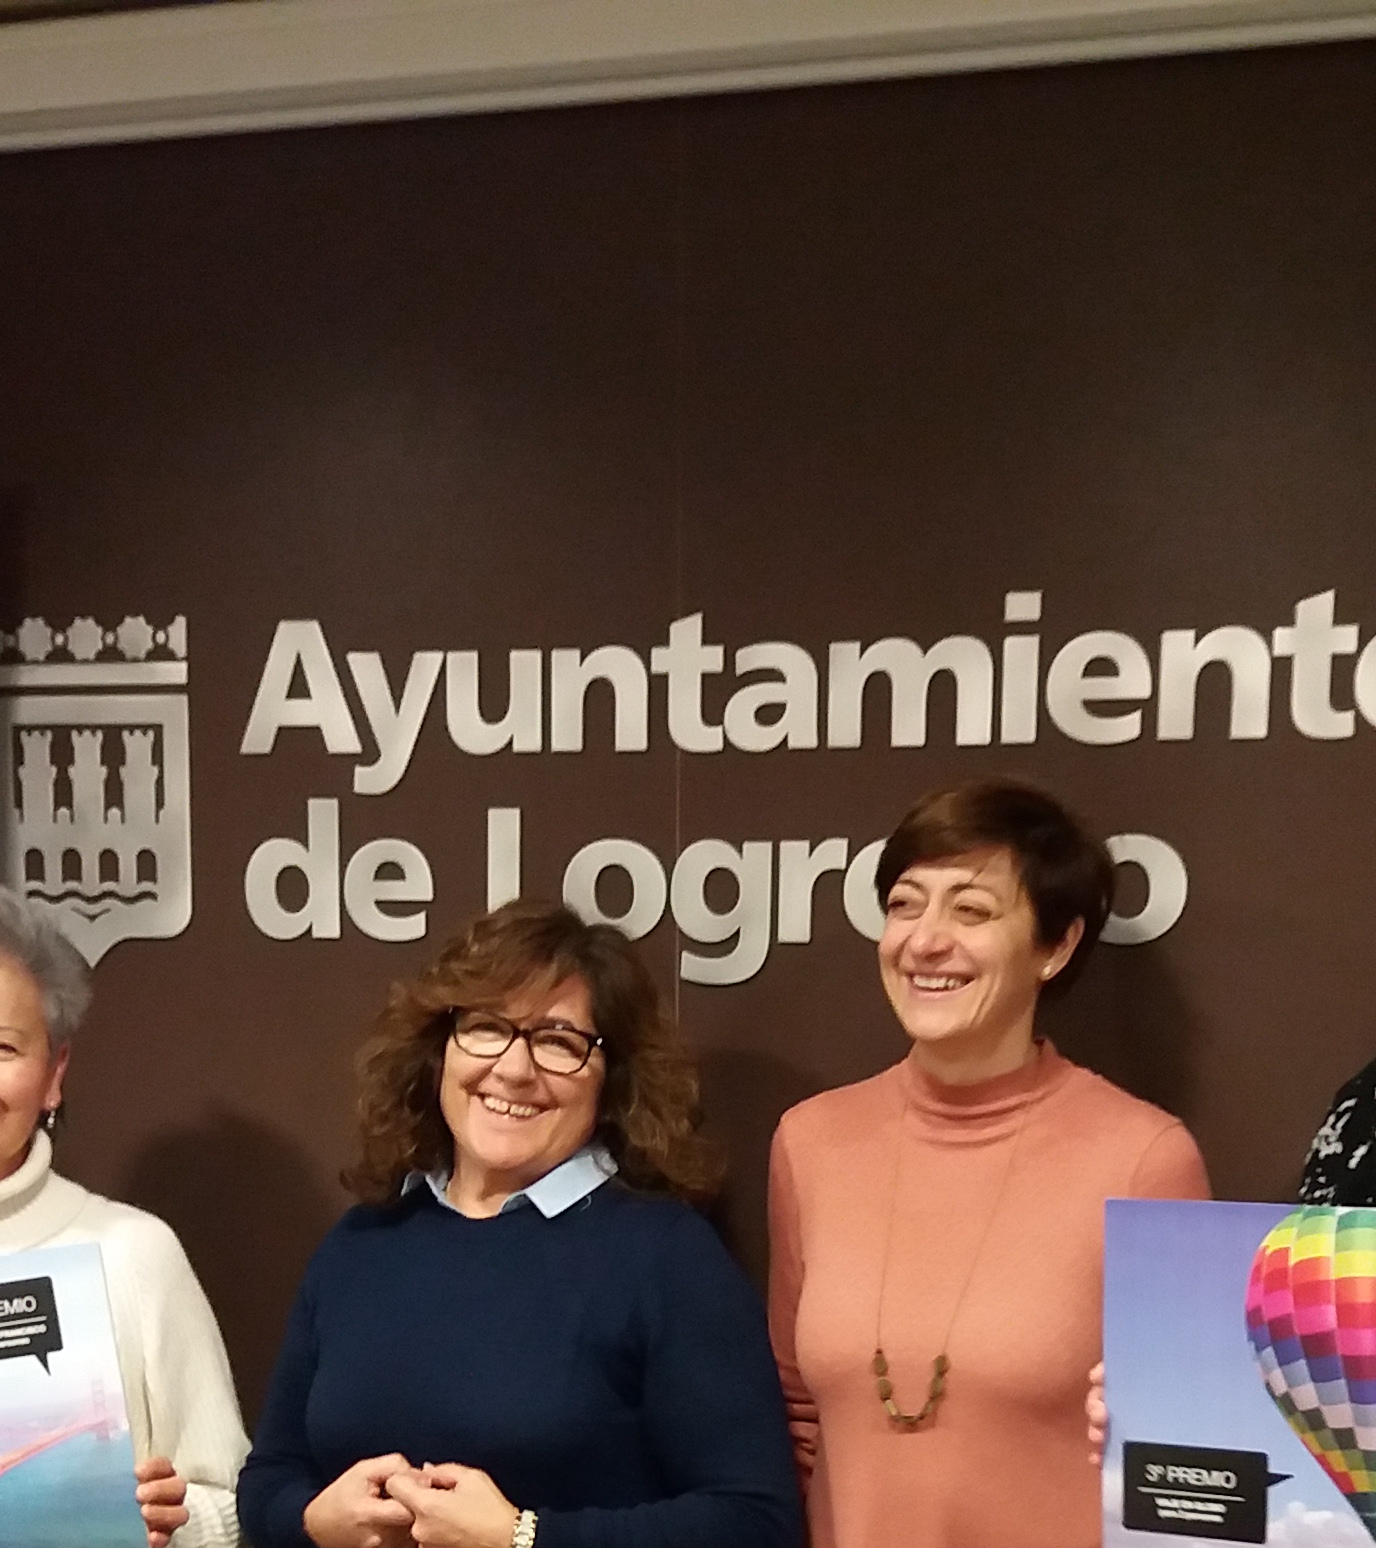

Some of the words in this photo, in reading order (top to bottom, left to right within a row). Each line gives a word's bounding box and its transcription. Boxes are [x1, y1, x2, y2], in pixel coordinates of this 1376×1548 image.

[245, 799, 434, 941] de
[486, 806, 1190, 986] Logro
[1165, 1464, 1238, 1490] PREMIO
